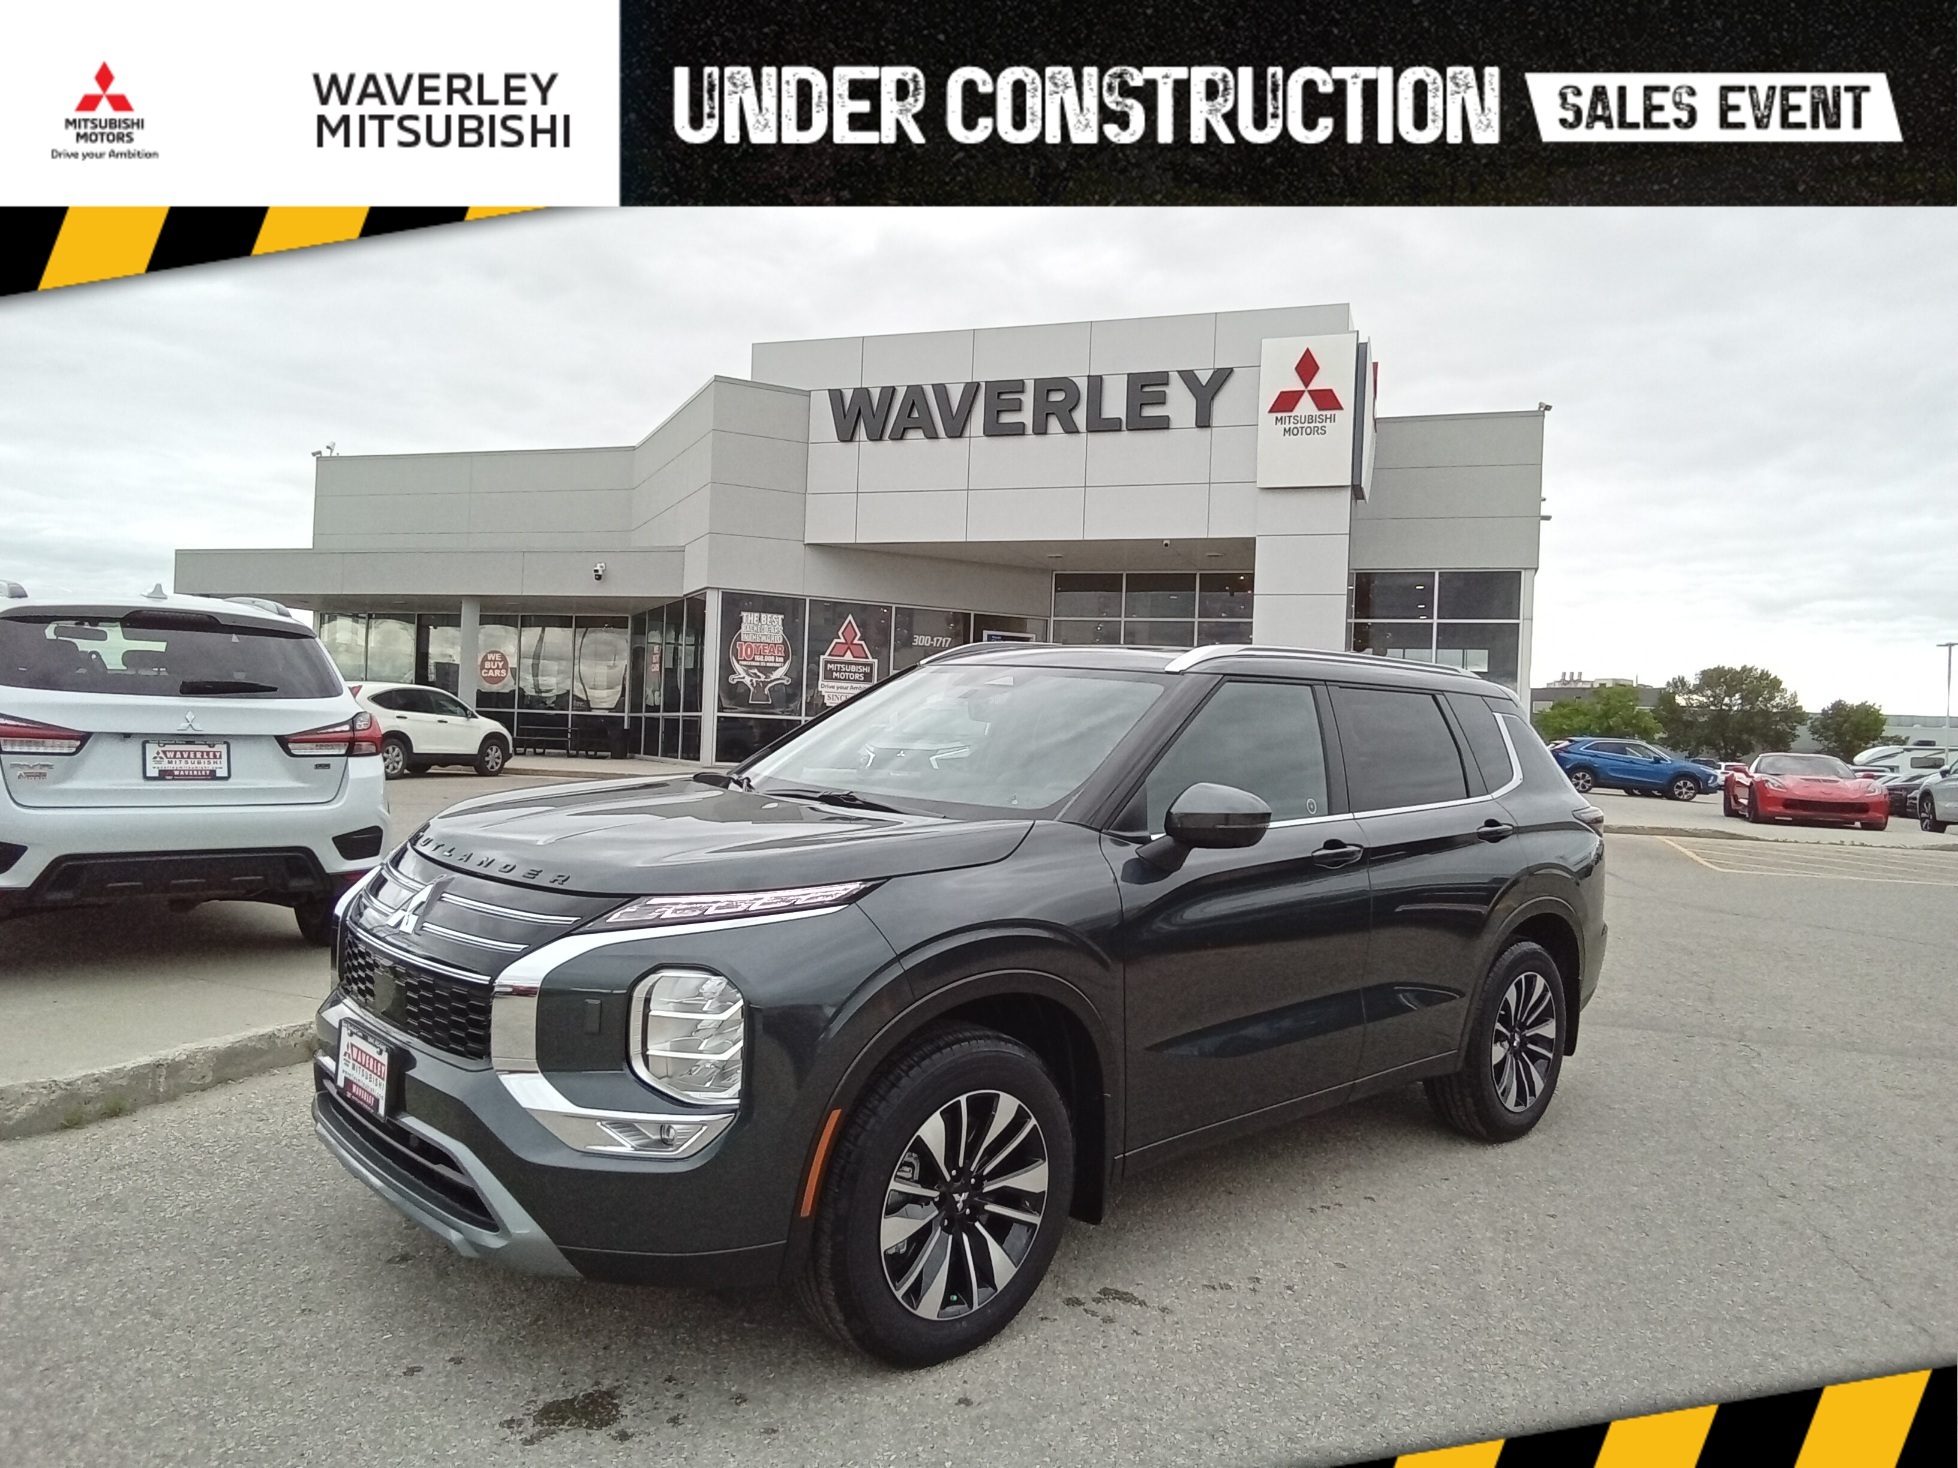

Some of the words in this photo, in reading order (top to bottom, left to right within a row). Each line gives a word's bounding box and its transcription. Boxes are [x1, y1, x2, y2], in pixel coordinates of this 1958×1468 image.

[827, 367, 1234, 443] WAVERLEY
[1275, 413, 1336, 425] MITSUBISHI
[1283, 425, 1327, 437] MOTORS
[741, 611, 760, 624] THE
[761, 613, 784, 626] BEST
[912, 635, 952, 648] 300-1717
[487, 653, 502, 661] WE
[737, 642, 755, 660] 10
[754, 643, 785, 656] YEAR
[484, 661, 504, 669] BUY
[827, 663, 871, 673] MITSUBISHI
[481, 669, 507, 677] CARS
[832, 672, 865, 681] MOTORS
[165, 751, 221, 759] WAVERLEY
[352, 1045, 386, 1080] WAVERLEY
